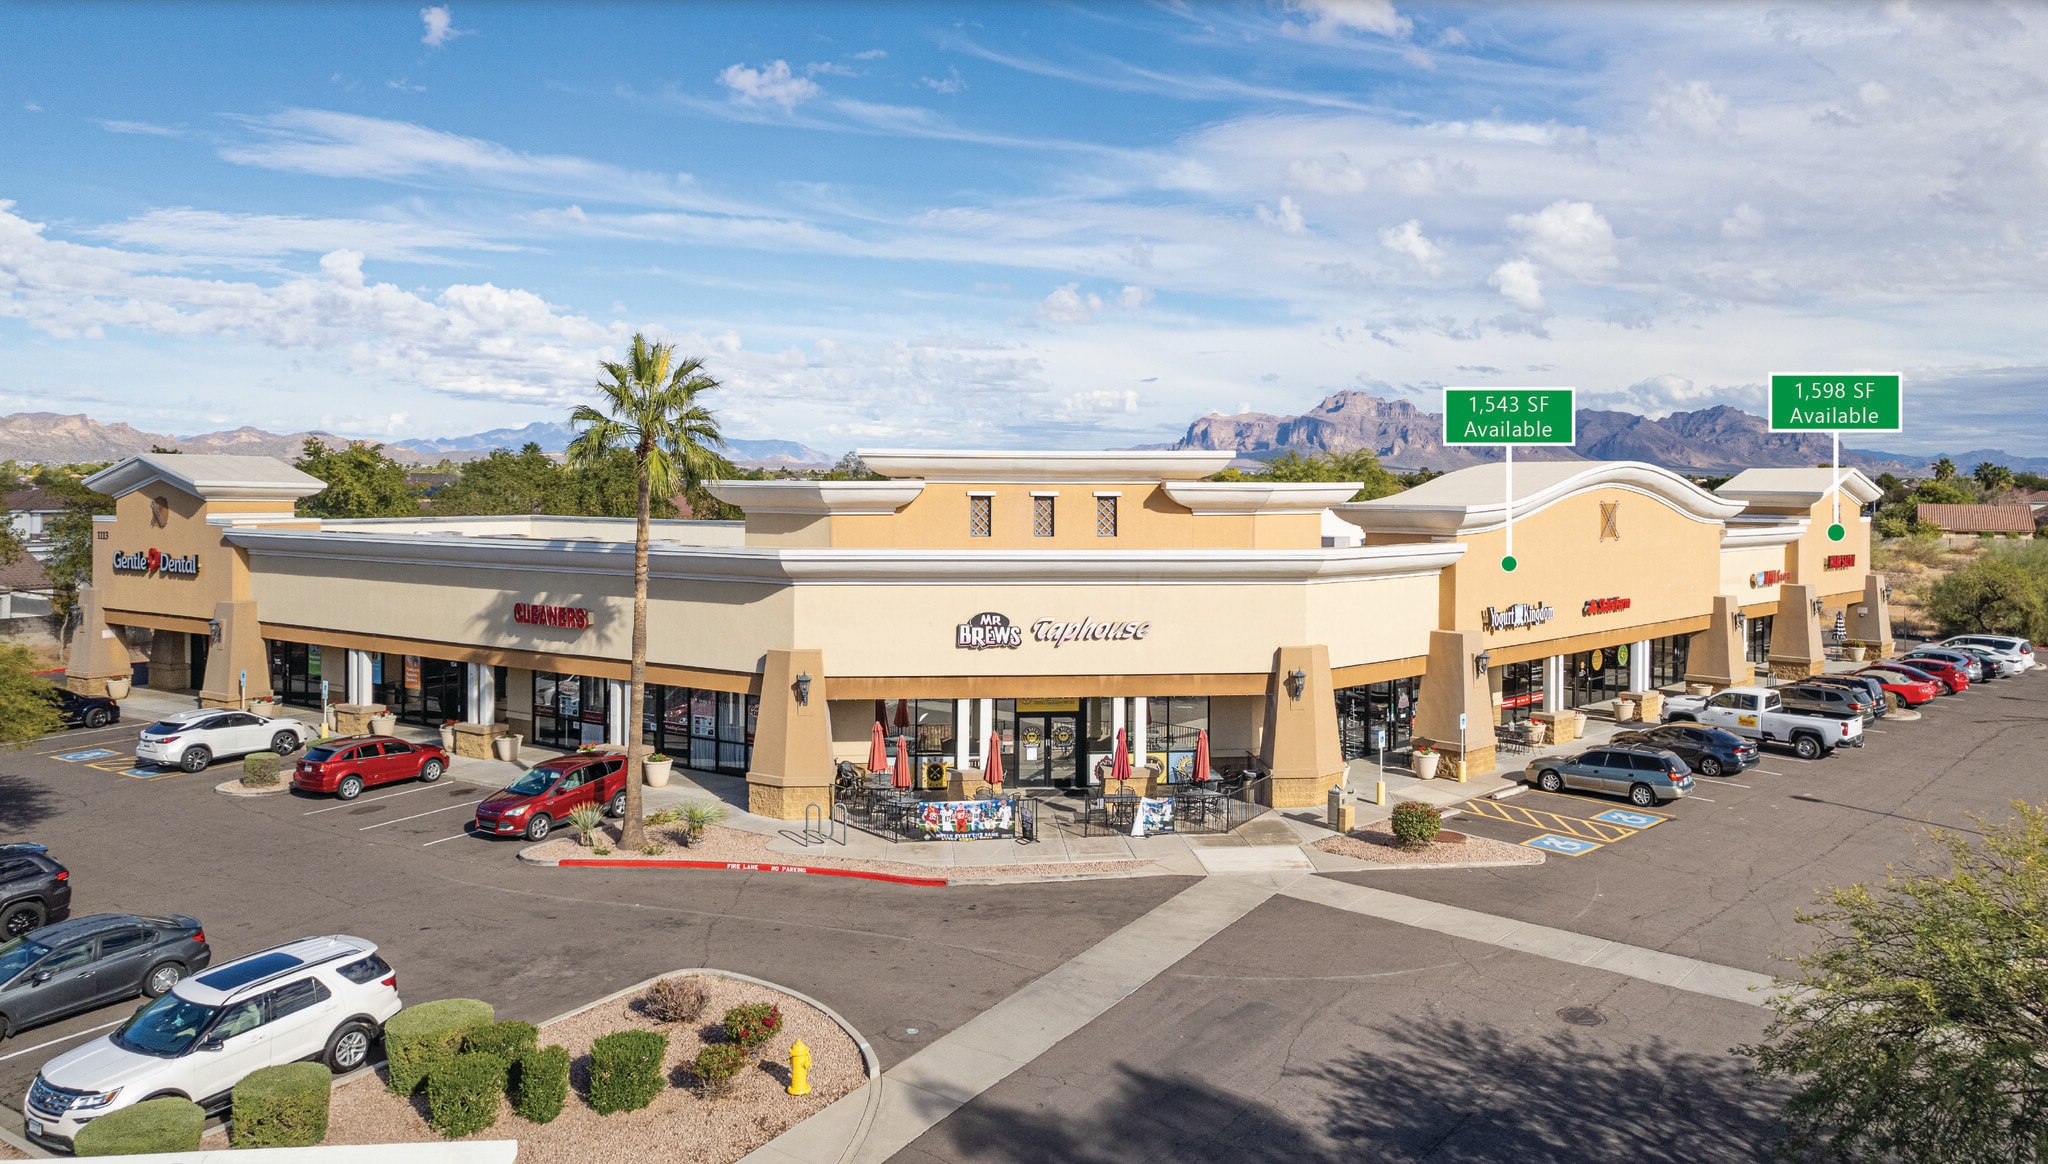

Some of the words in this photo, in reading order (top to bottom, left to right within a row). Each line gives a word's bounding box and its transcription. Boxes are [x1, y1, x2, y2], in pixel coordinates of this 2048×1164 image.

[97, 531, 109, 540] 1113
[113, 550, 148, 571] Gentle
[160, 552, 198, 574] Dental
[513, 602, 590, 630] CLEANERS
[1489, 606, 1515, 631] Yogurt
[1523, 601, 1555, 626] Kingdom
[956, 623, 1022, 648] BREWS
[980, 614, 1002, 627] MR
[1031, 615, 1152, 649] Taphouse
